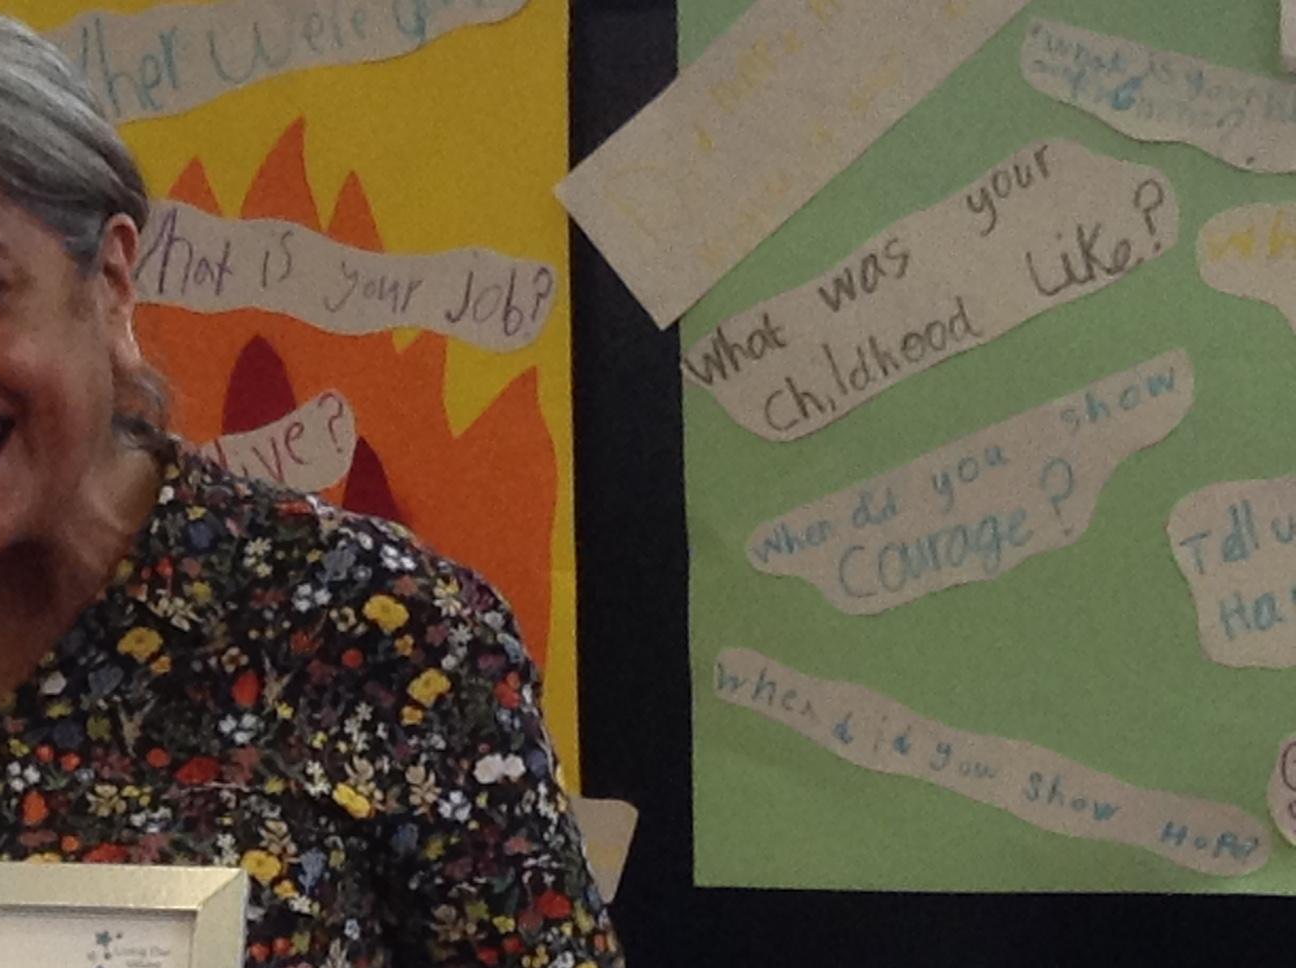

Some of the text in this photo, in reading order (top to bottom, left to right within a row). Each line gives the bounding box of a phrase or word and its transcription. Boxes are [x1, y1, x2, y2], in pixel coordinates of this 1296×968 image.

[817, 238, 909, 313] was
[965, 144, 1049, 238] your
[323, 261, 425, 314] your
[764, 296, 983, 431] Childhood
[851, 486, 899, 530] did
[932, 444, 1009, 515] you
